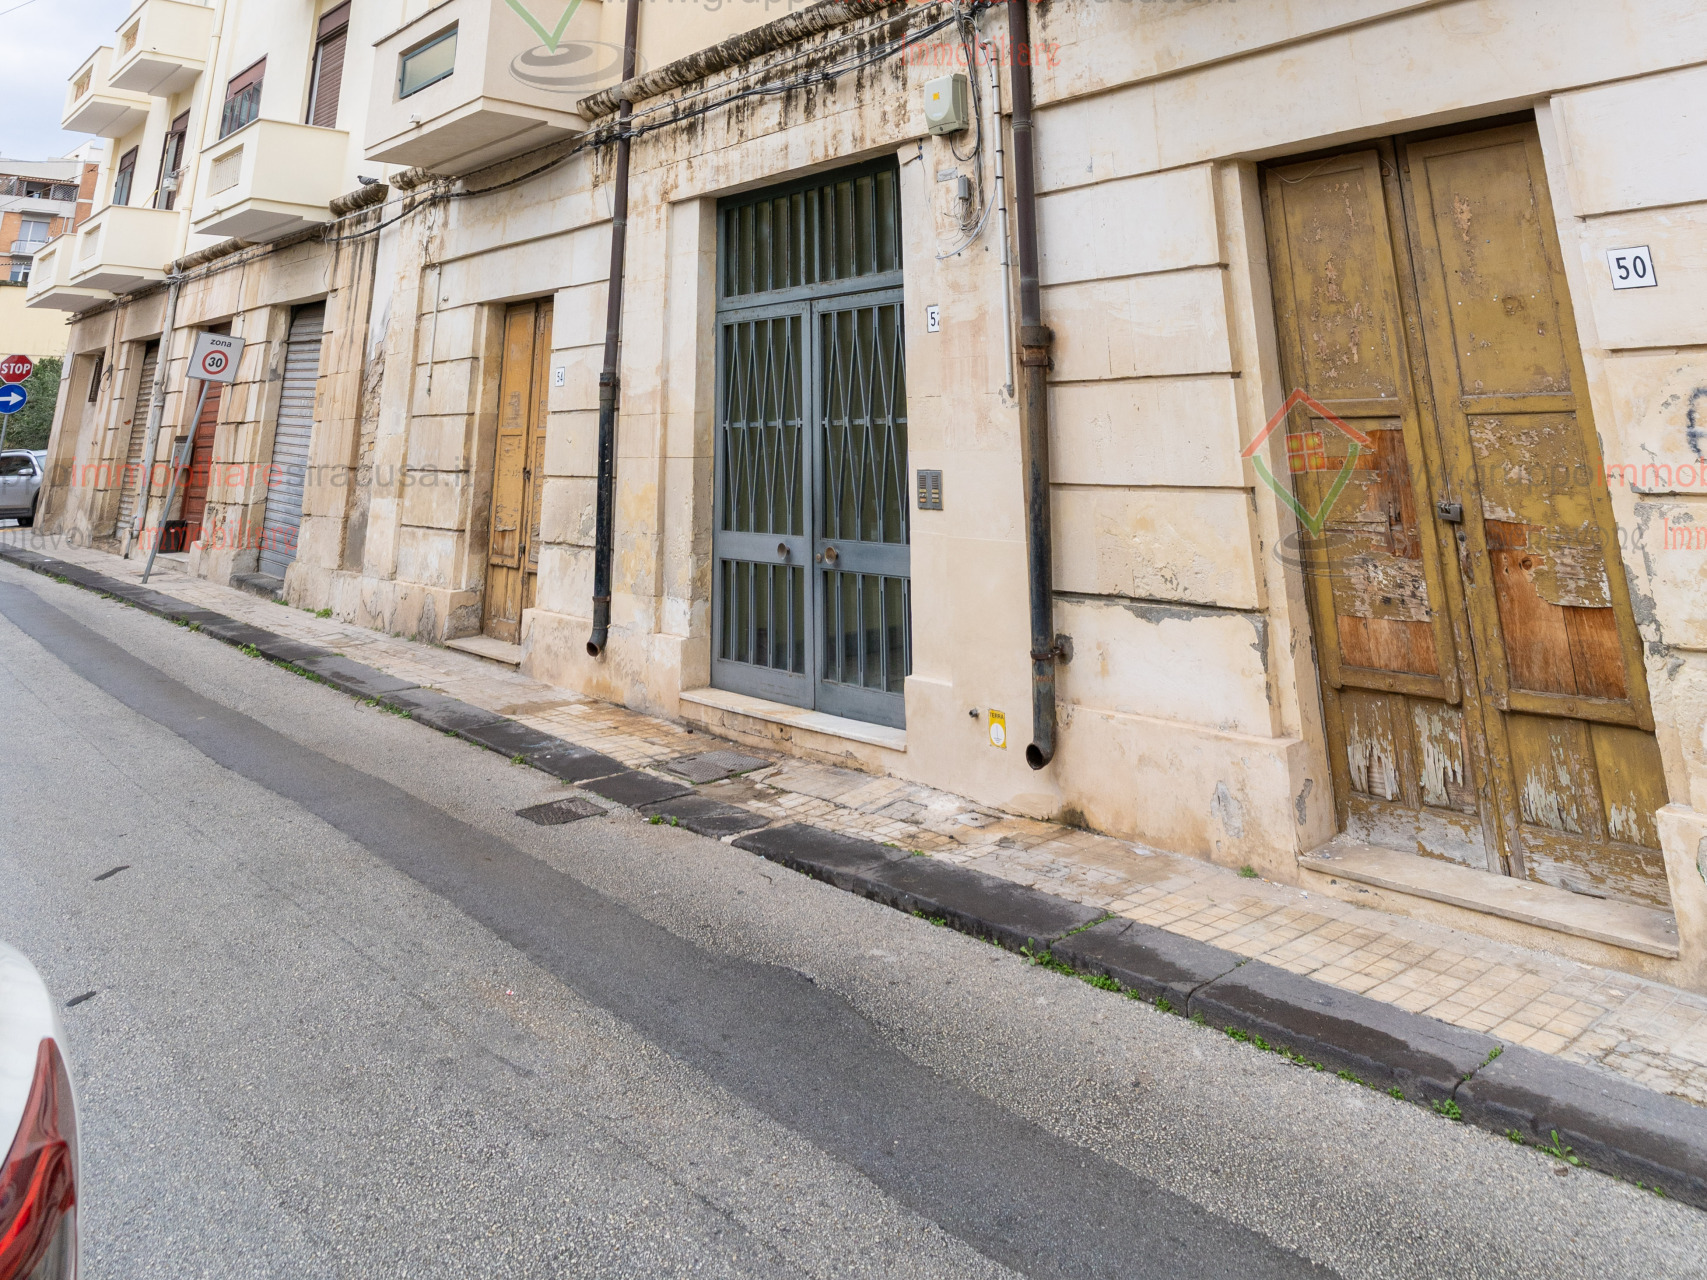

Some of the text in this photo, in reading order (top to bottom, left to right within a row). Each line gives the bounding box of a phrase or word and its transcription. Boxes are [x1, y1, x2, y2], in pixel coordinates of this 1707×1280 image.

[1615, 255, 1647, 280] 50
[210, 338, 232, 348] zona
[0, 363, 31, 375] STOP
[208, 357, 223, 369] 30
